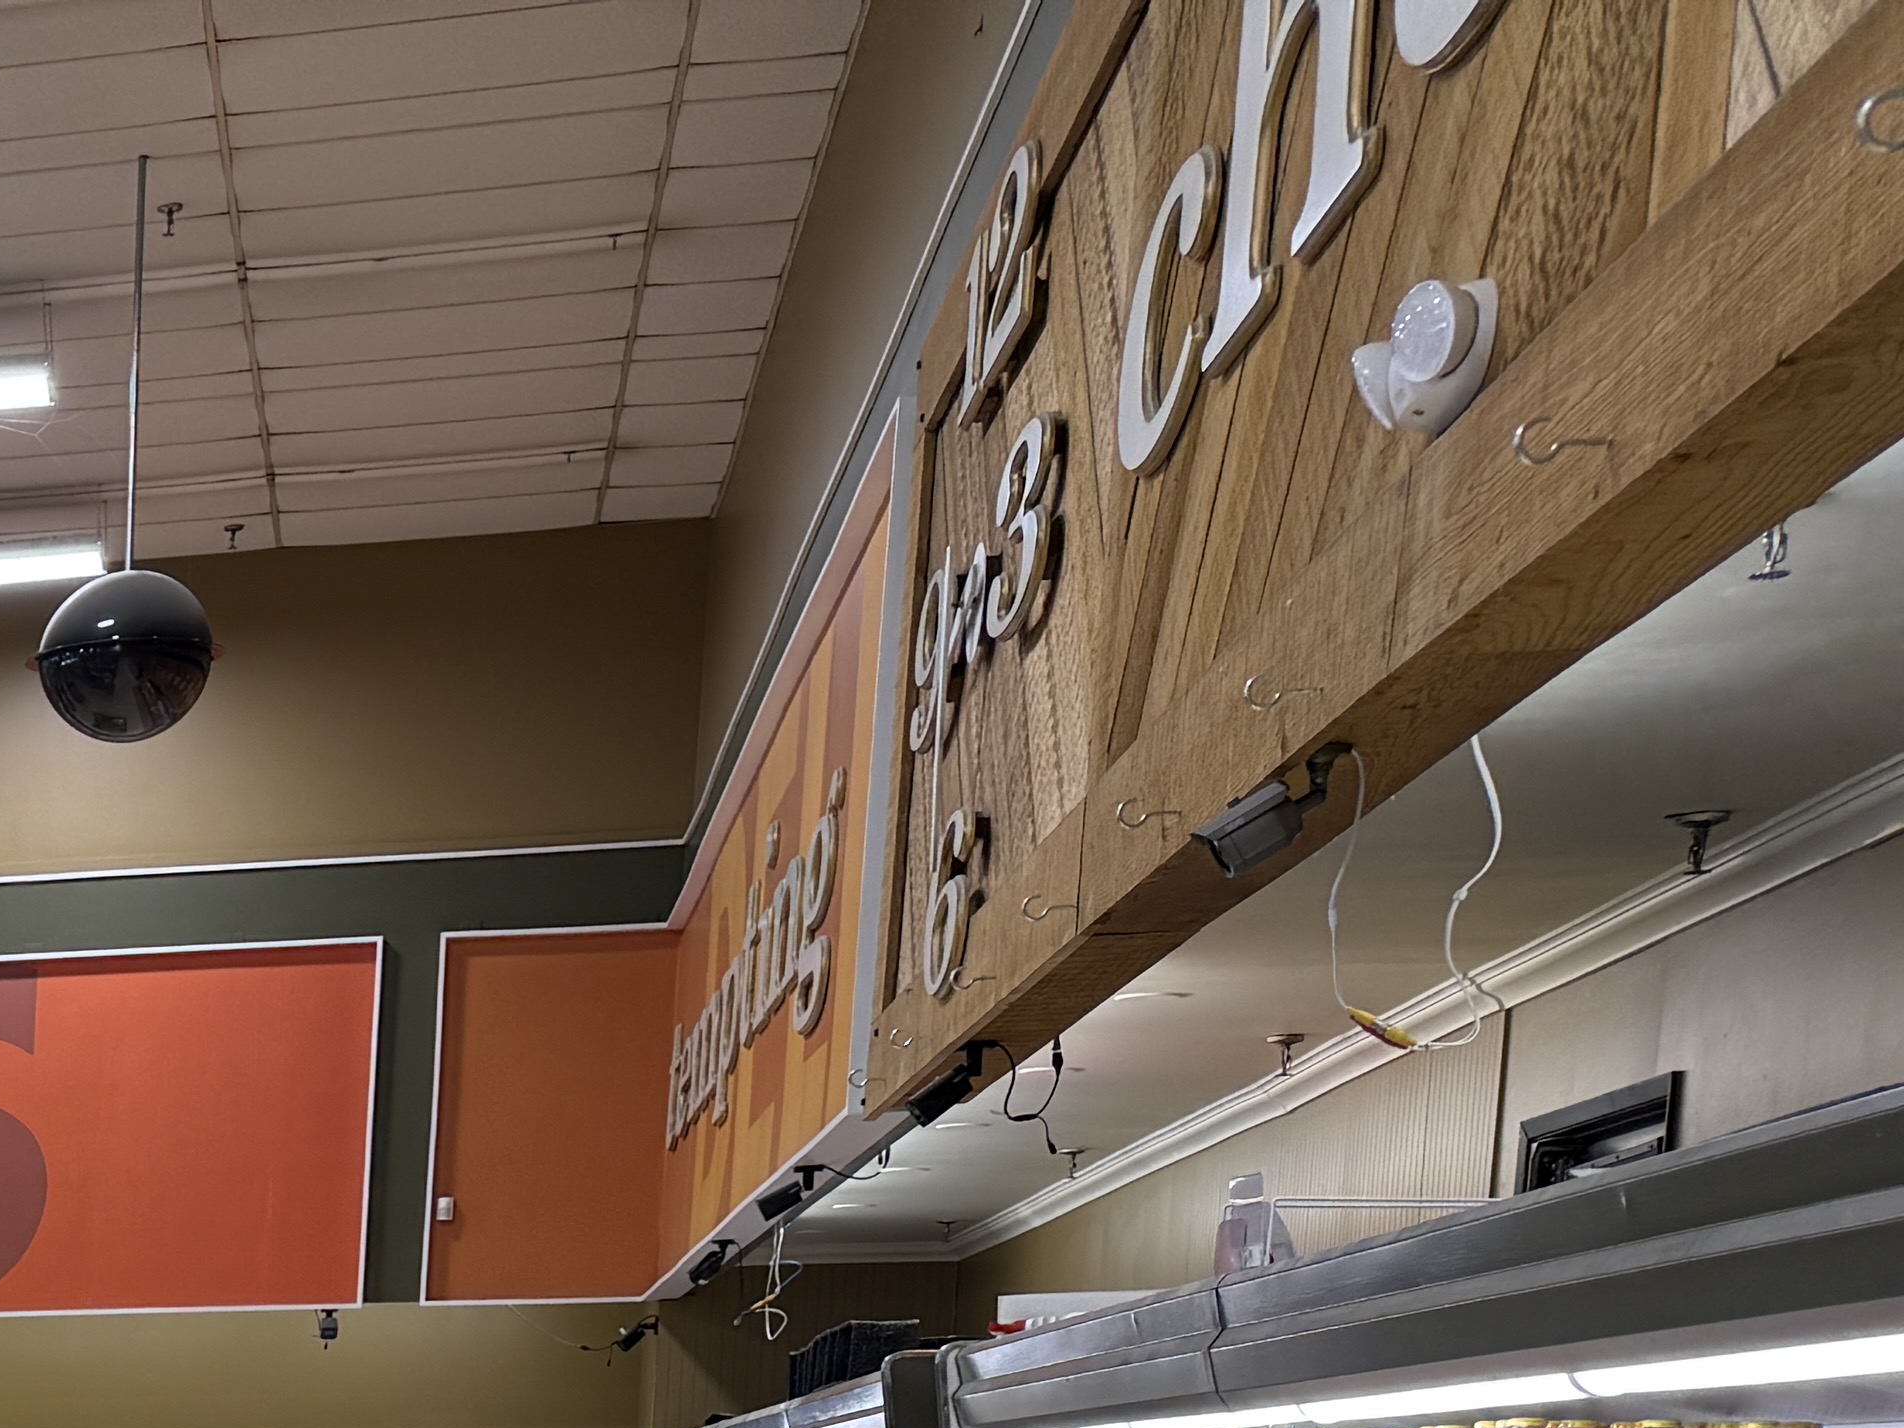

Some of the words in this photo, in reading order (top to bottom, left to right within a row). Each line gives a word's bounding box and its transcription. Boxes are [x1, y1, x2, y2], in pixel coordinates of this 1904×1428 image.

[986, 411, 1064, 643] 3
[666, 766, 848, 1152] tempting
[924, 806, 977, 1000] 6
